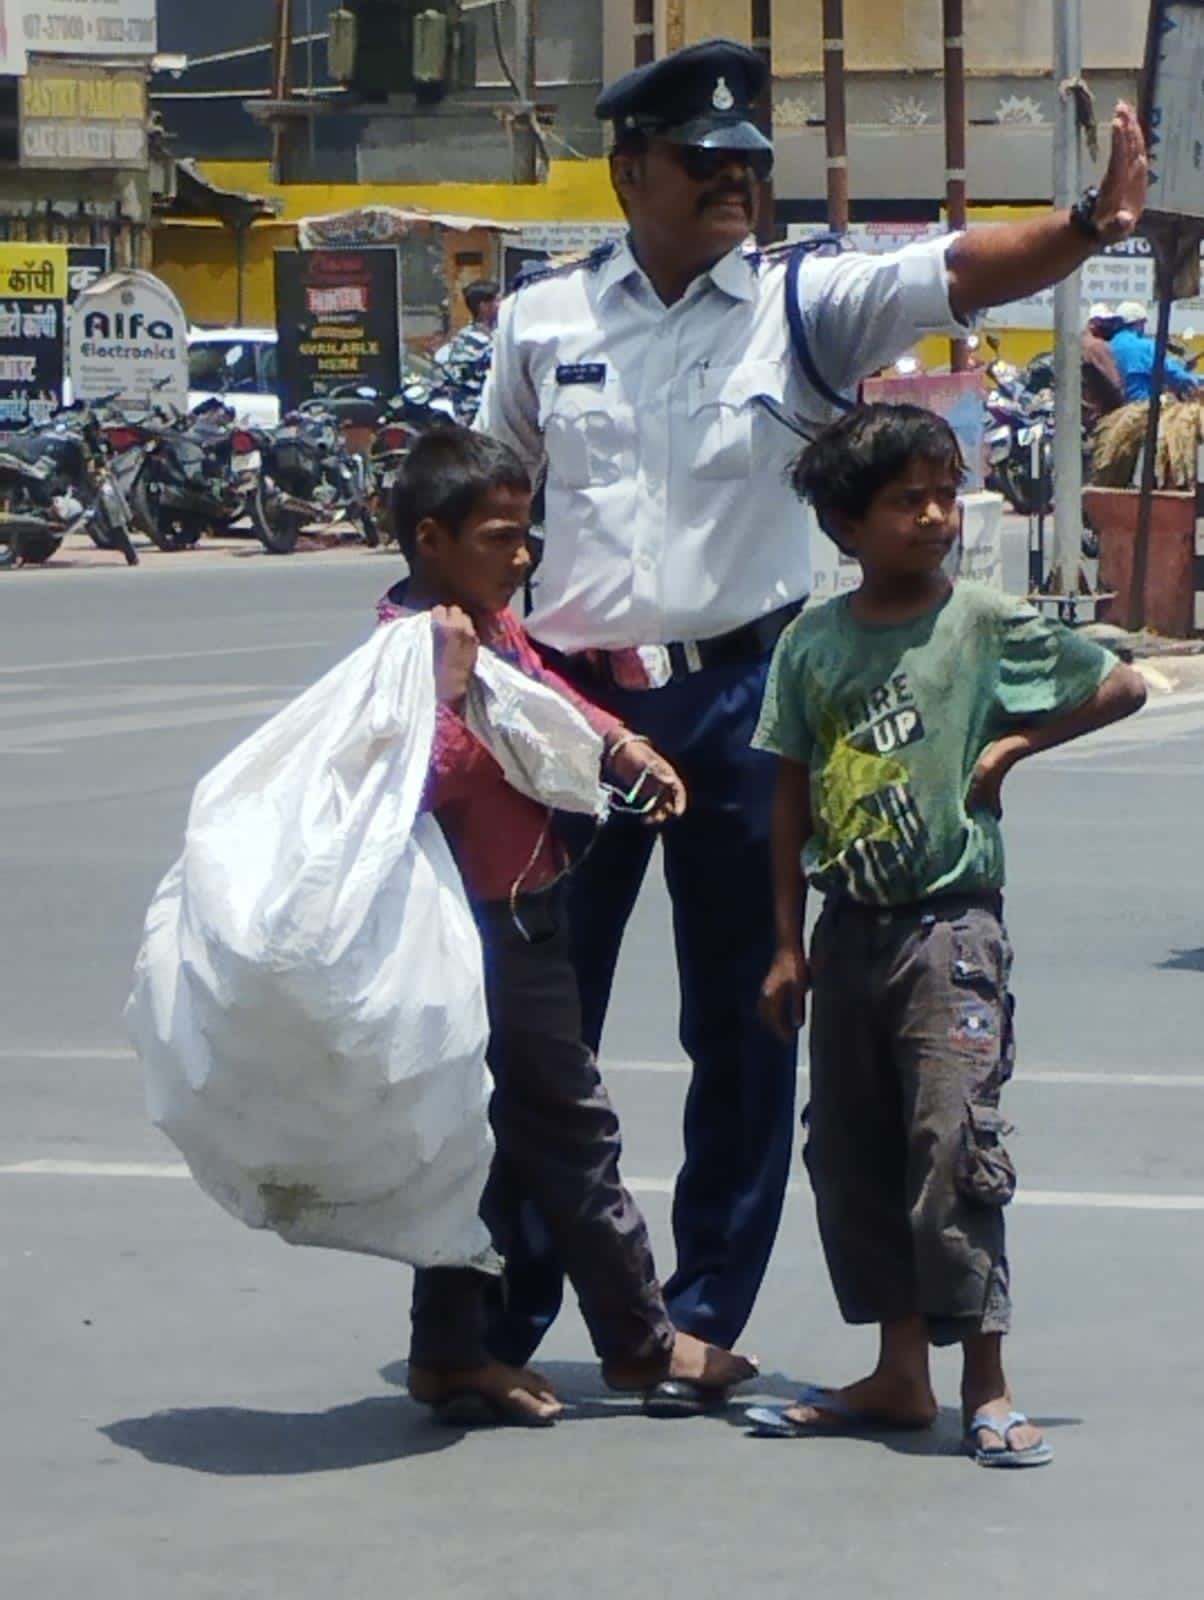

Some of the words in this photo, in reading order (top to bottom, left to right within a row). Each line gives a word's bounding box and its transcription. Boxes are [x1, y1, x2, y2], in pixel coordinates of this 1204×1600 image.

[85, 311, 173, 339] Alfa
[80, 342, 176, 359] Electronics
[872, 709, 917, 752] UP
